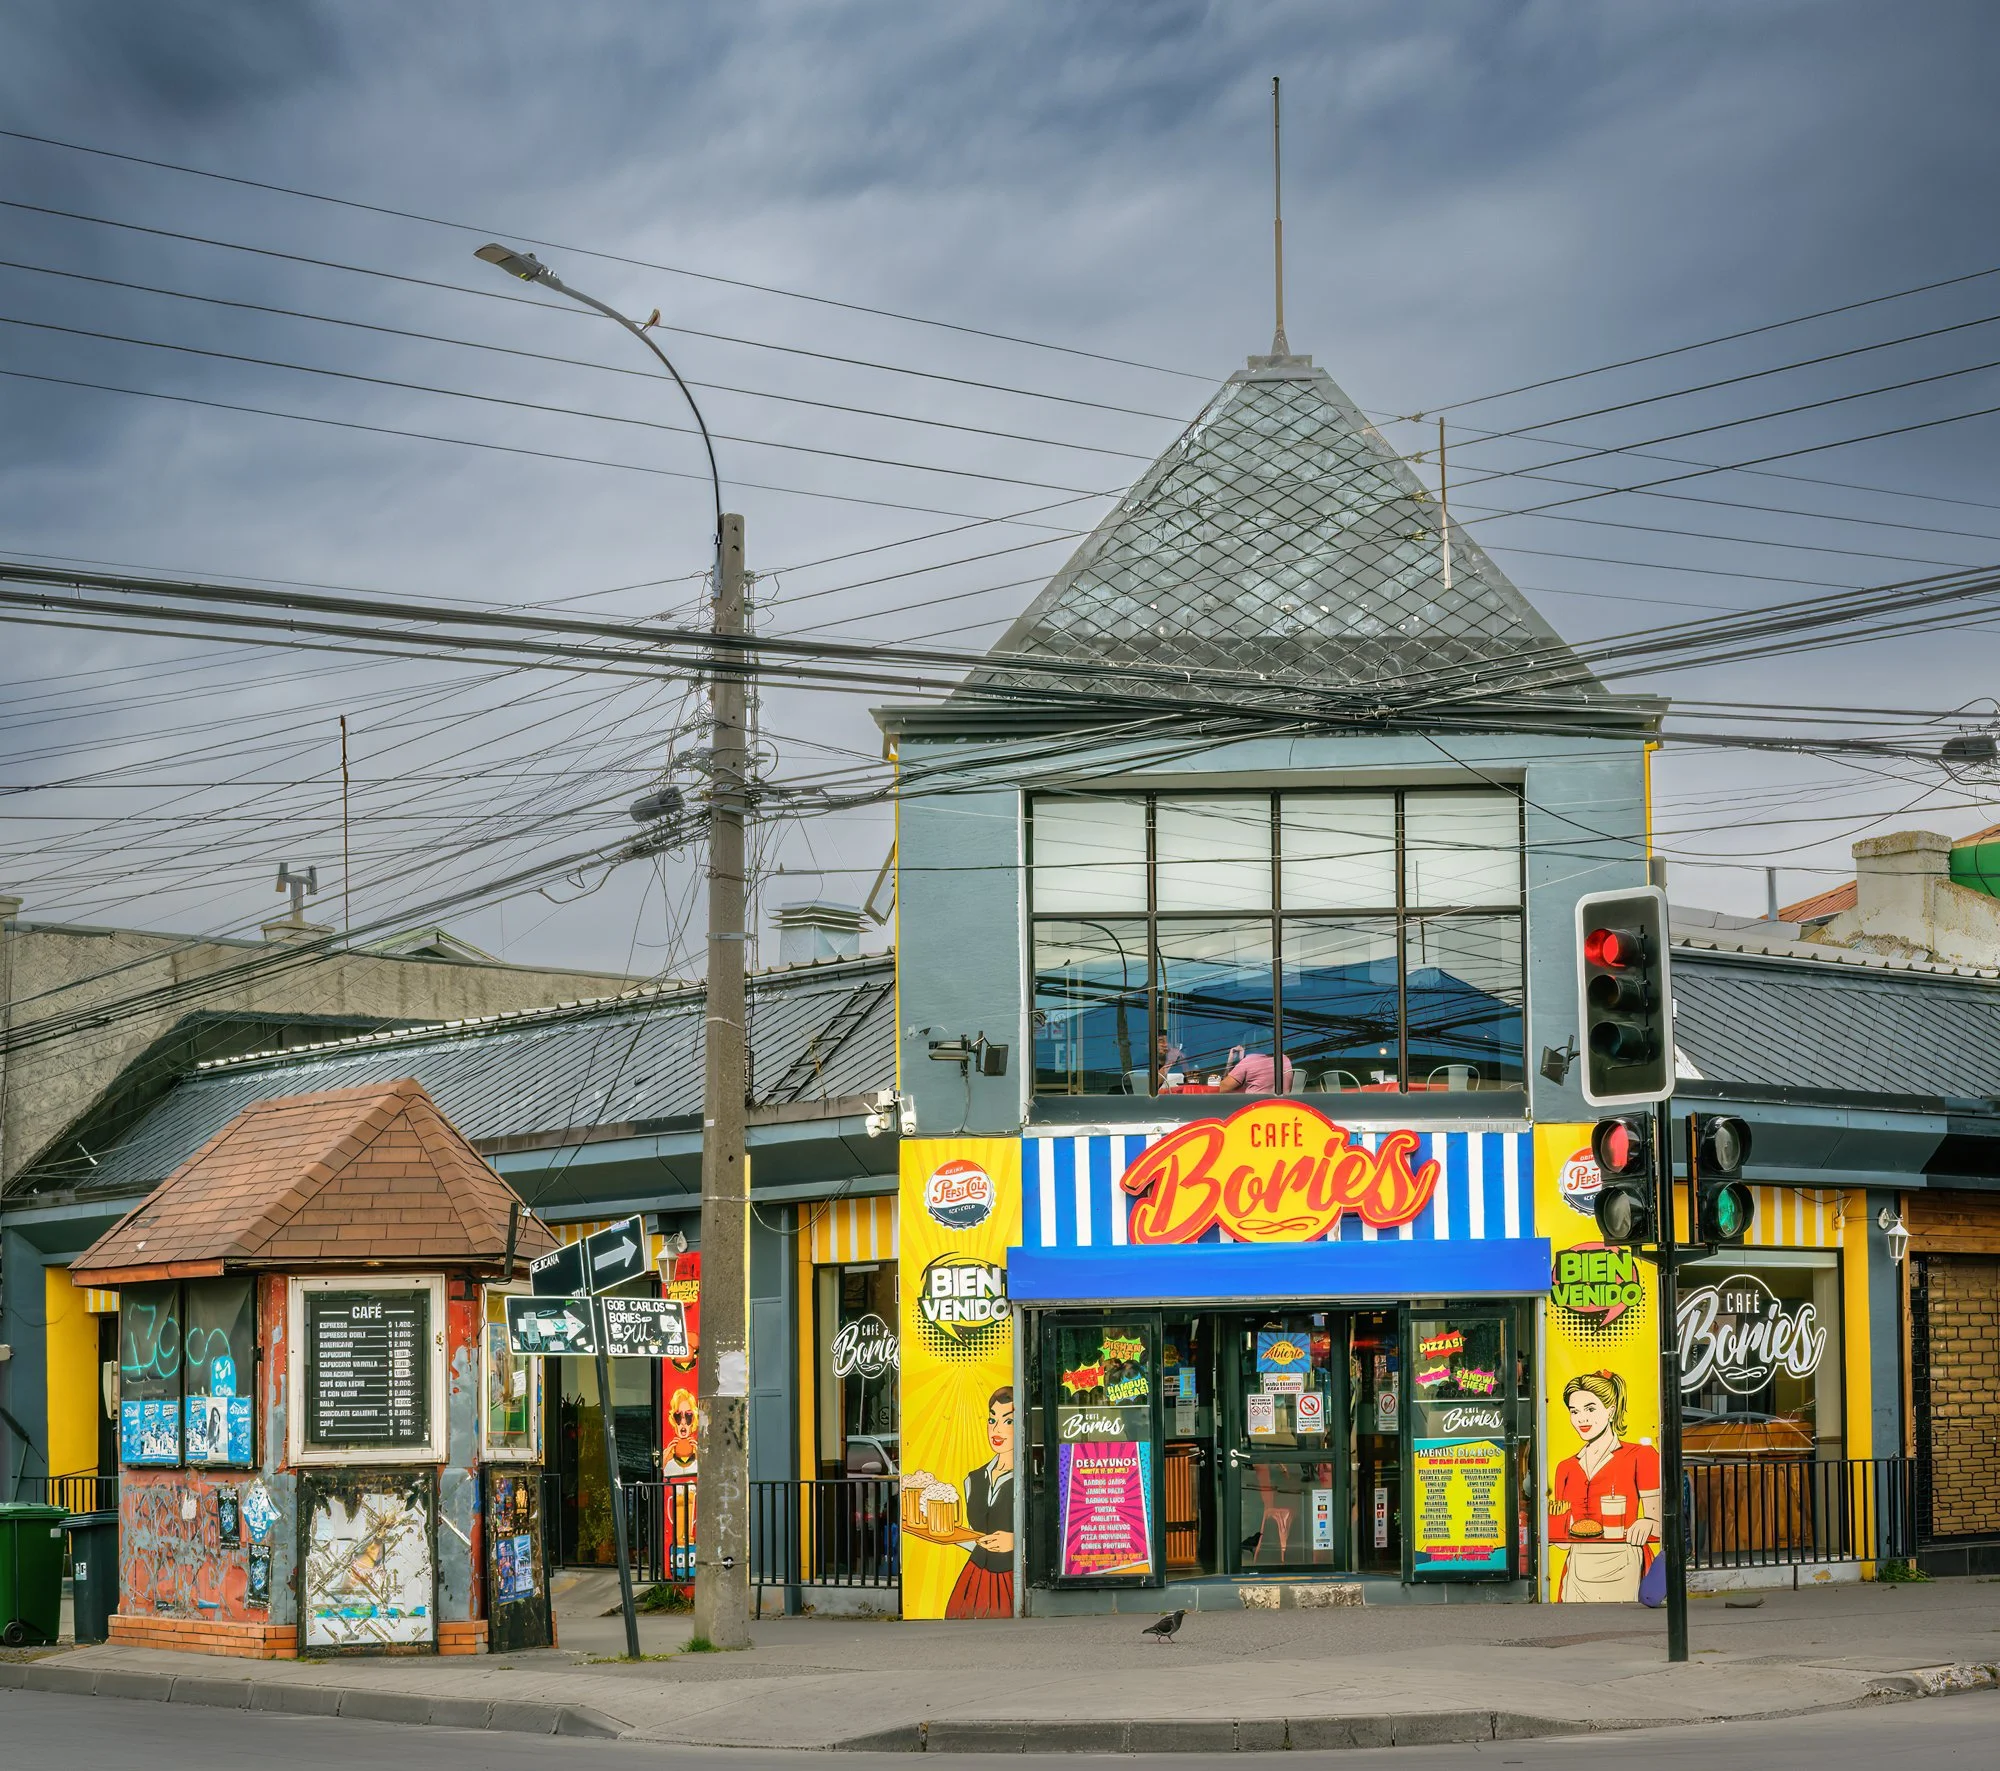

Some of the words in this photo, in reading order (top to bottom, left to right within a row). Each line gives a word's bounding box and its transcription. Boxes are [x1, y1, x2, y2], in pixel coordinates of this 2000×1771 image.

[1251, 1116, 1303, 1148] CAFÉ
[1125, 1126, 1437, 1244] Bories
[1560, 1252, 1633, 1284] BIEN
[931, 1266, 1001, 1298] BIEN
[607, 1301, 626, 1311] GOB
[630, 1301, 665, 1312] CARLOS
[1551, 1282, 1643, 1308] VENIDO
[1726, 1289, 1760, 1314] CAFÉ
[352, 1302, 382, 1319] CAFÉ
[609, 1312, 642, 1323] BORIES
[921, 1297, 1011, 1322] VENIDO
[861, 1322, 880, 1337] CAFÉ
[1677, 1291, 1825, 1387] Bories
[610, 1344, 629, 1354] 601
[667, 1345, 686, 1355] 699
[1419, 1337, 1463, 1353] PIZZAS!
[1062, 1413, 1125, 1439] Bories
[1442, 1407, 1504, 1433] Bories
[1076, 1458, 1137, 1468] DESAYUNOS
[1457, 1447, 1501, 1457] DIARIOS
